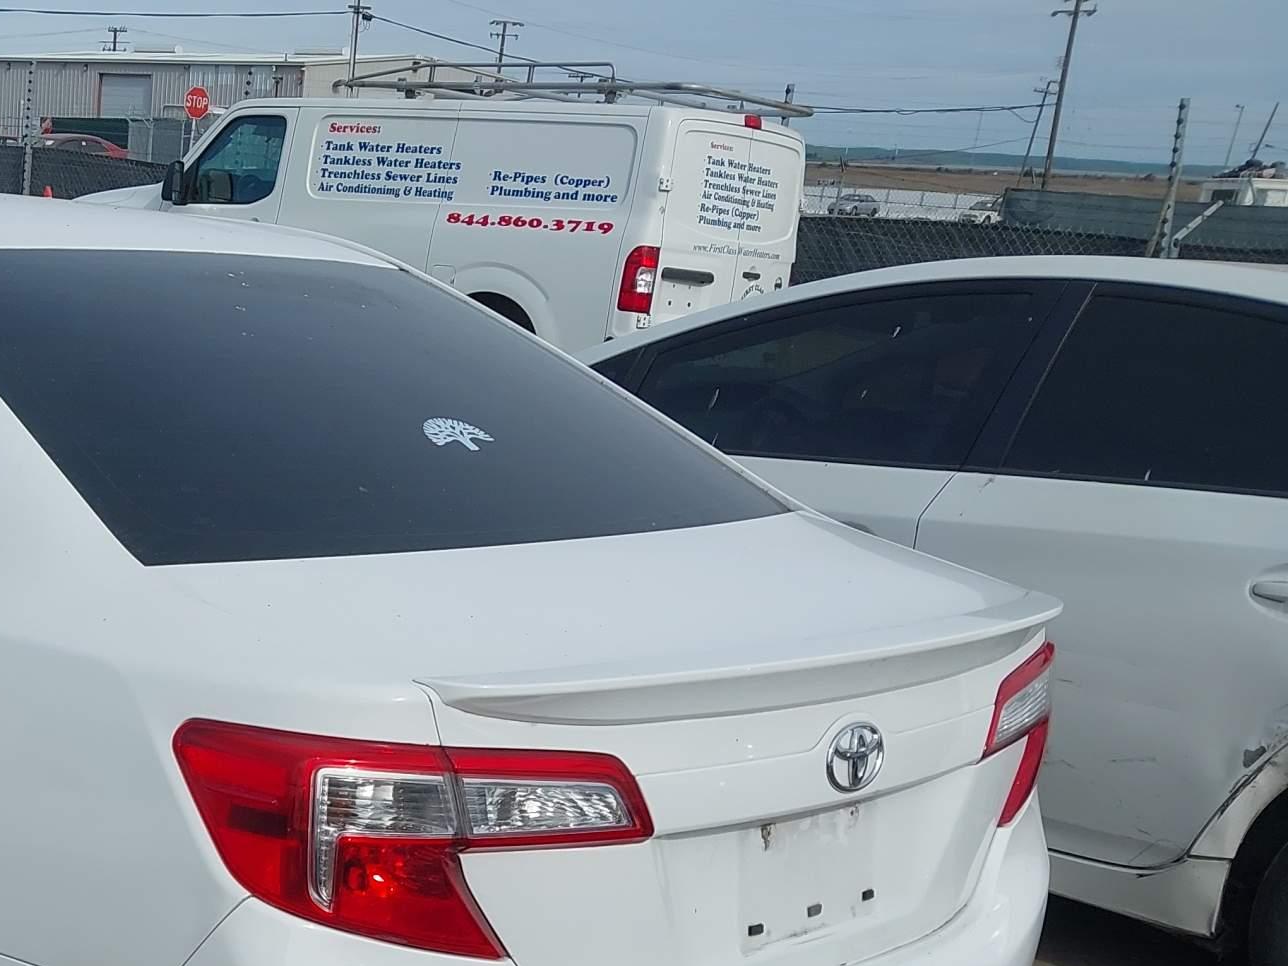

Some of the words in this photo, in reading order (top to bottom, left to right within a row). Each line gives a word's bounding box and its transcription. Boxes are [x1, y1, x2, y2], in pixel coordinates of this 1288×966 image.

[187, 95, 208, 108] STOP
[329, 122, 381, 134] Services:
[325, 141, 354, 152] Tank
[358, 142, 392, 153] Water
[396, 143, 443, 154] Heaters
[323, 155, 372, 166] Tankless
[376, 157, 411, 168] Water
[414, 158, 462, 170] Heaters
[707, 155, 725, 167] Tank
[727, 159, 747, 171] Water
[748, 163, 771, 175] Heaters
[320, 168, 381, 181] Trenchless
[384, 171, 422, 182] Sewer
[425, 173, 458, 184] Lines
[492, 170, 547, 185] Re-Pipes
[554, 174, 610, 188] (Copper)
[705, 168, 735, 181] Tankless
[737, 172, 756, 185] Water
[757, 177, 779, 189] Heaters
[318, 182, 333, 192] Air
[403, 185, 413, 196] &
[415, 187, 454, 201] Heating
[490, 185, 552, 201] Plumbing
[553, 190, 579, 201] and
[582, 193, 618, 203] more
[703, 179, 740, 193] Trenchless
[742, 186, 761, 197] Sewer
[762, 189, 777, 200] Lines
[702, 190, 712, 200] Air
[756, 199, 775, 212] Heating
[700, 203, 729, 216] Re-Pipes
[731, 206, 760, 221] (Copper)
[446, 212, 614, 235] 844.860.3719
[698, 214, 732, 230] Plumbing
[733, 220, 745, 230] and
[746, 224, 761, 232] more
